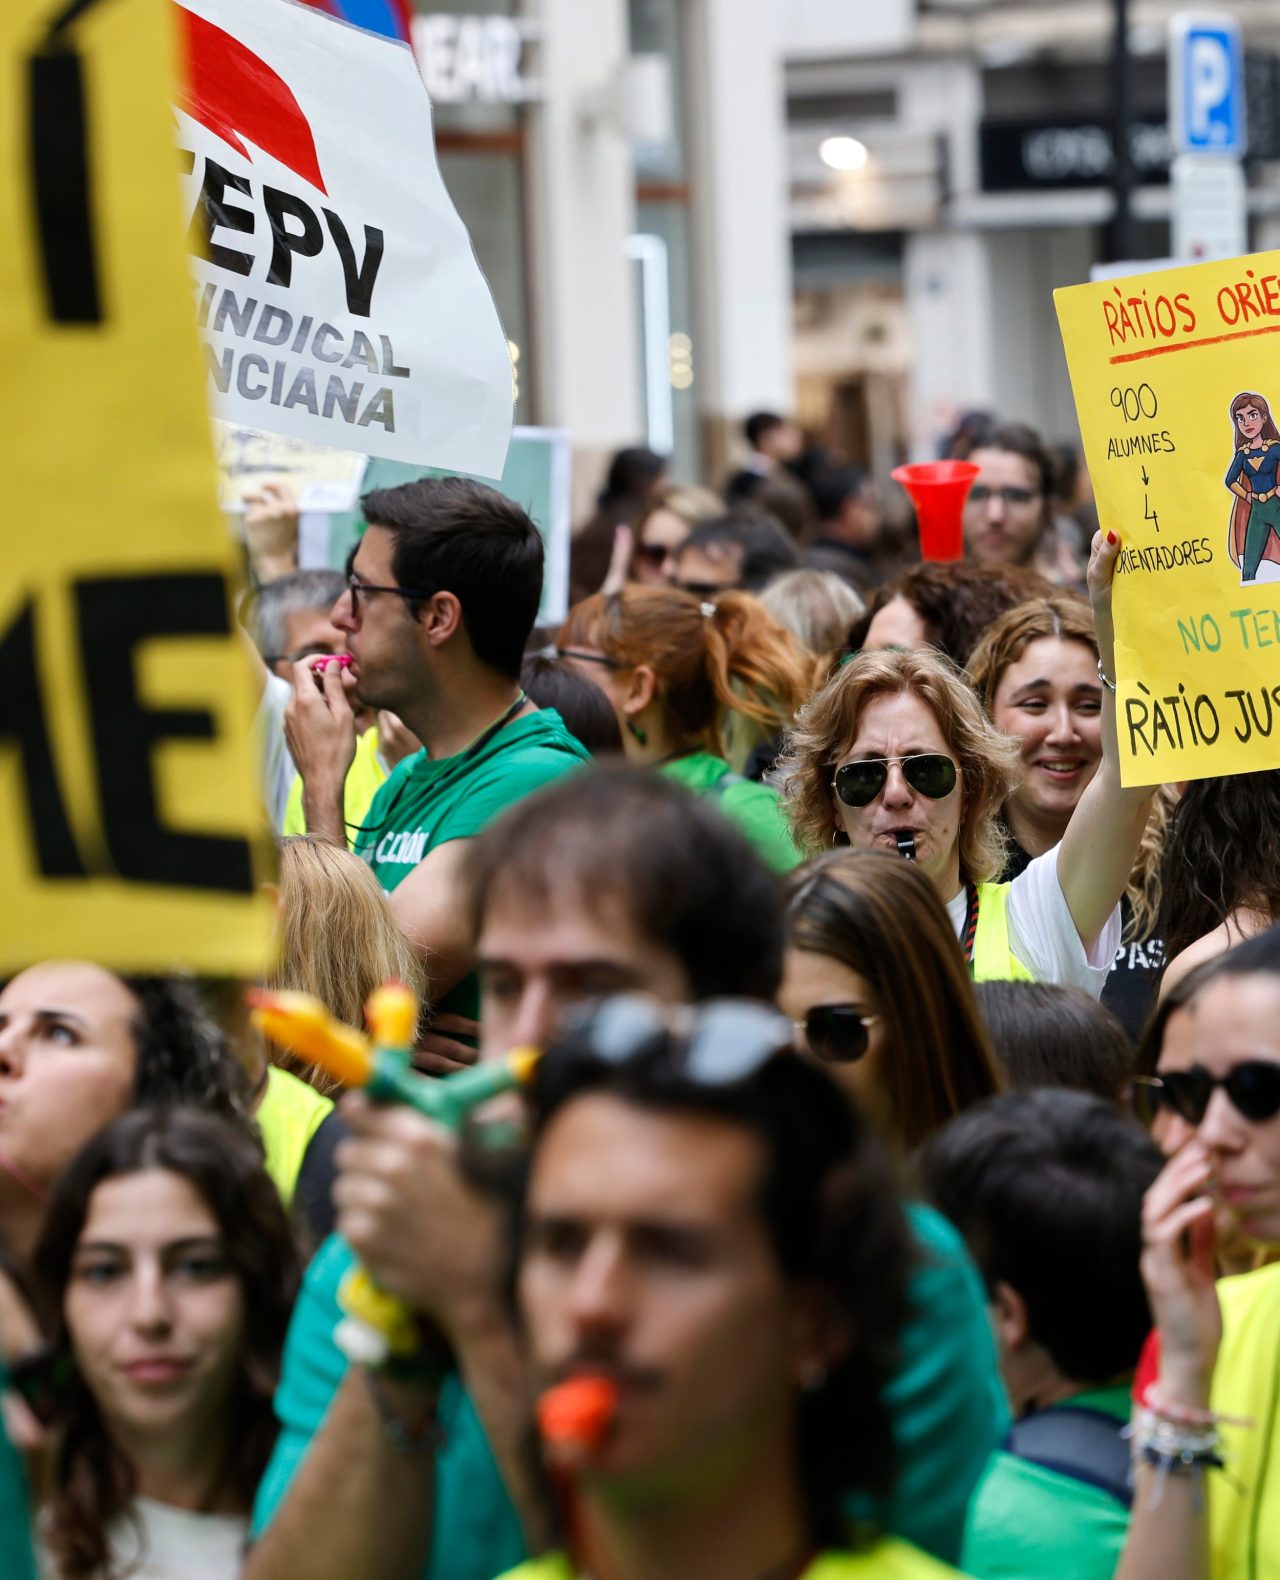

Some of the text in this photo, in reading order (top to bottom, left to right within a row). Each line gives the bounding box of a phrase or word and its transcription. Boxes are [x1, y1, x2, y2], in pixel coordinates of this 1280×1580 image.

[1190, 37, 1230, 135] P
[178, 147, 384, 318] EPV
[195, 277, 411, 379] INDICAL
[1111, 383, 1158, 423] 900
[1108, 431, 1176, 460] ALUMNES
[1144, 493, 1160, 533] 4
[1177, 617, 1222, 656] NO
[1125, 681, 1221, 757] RÀTIO
